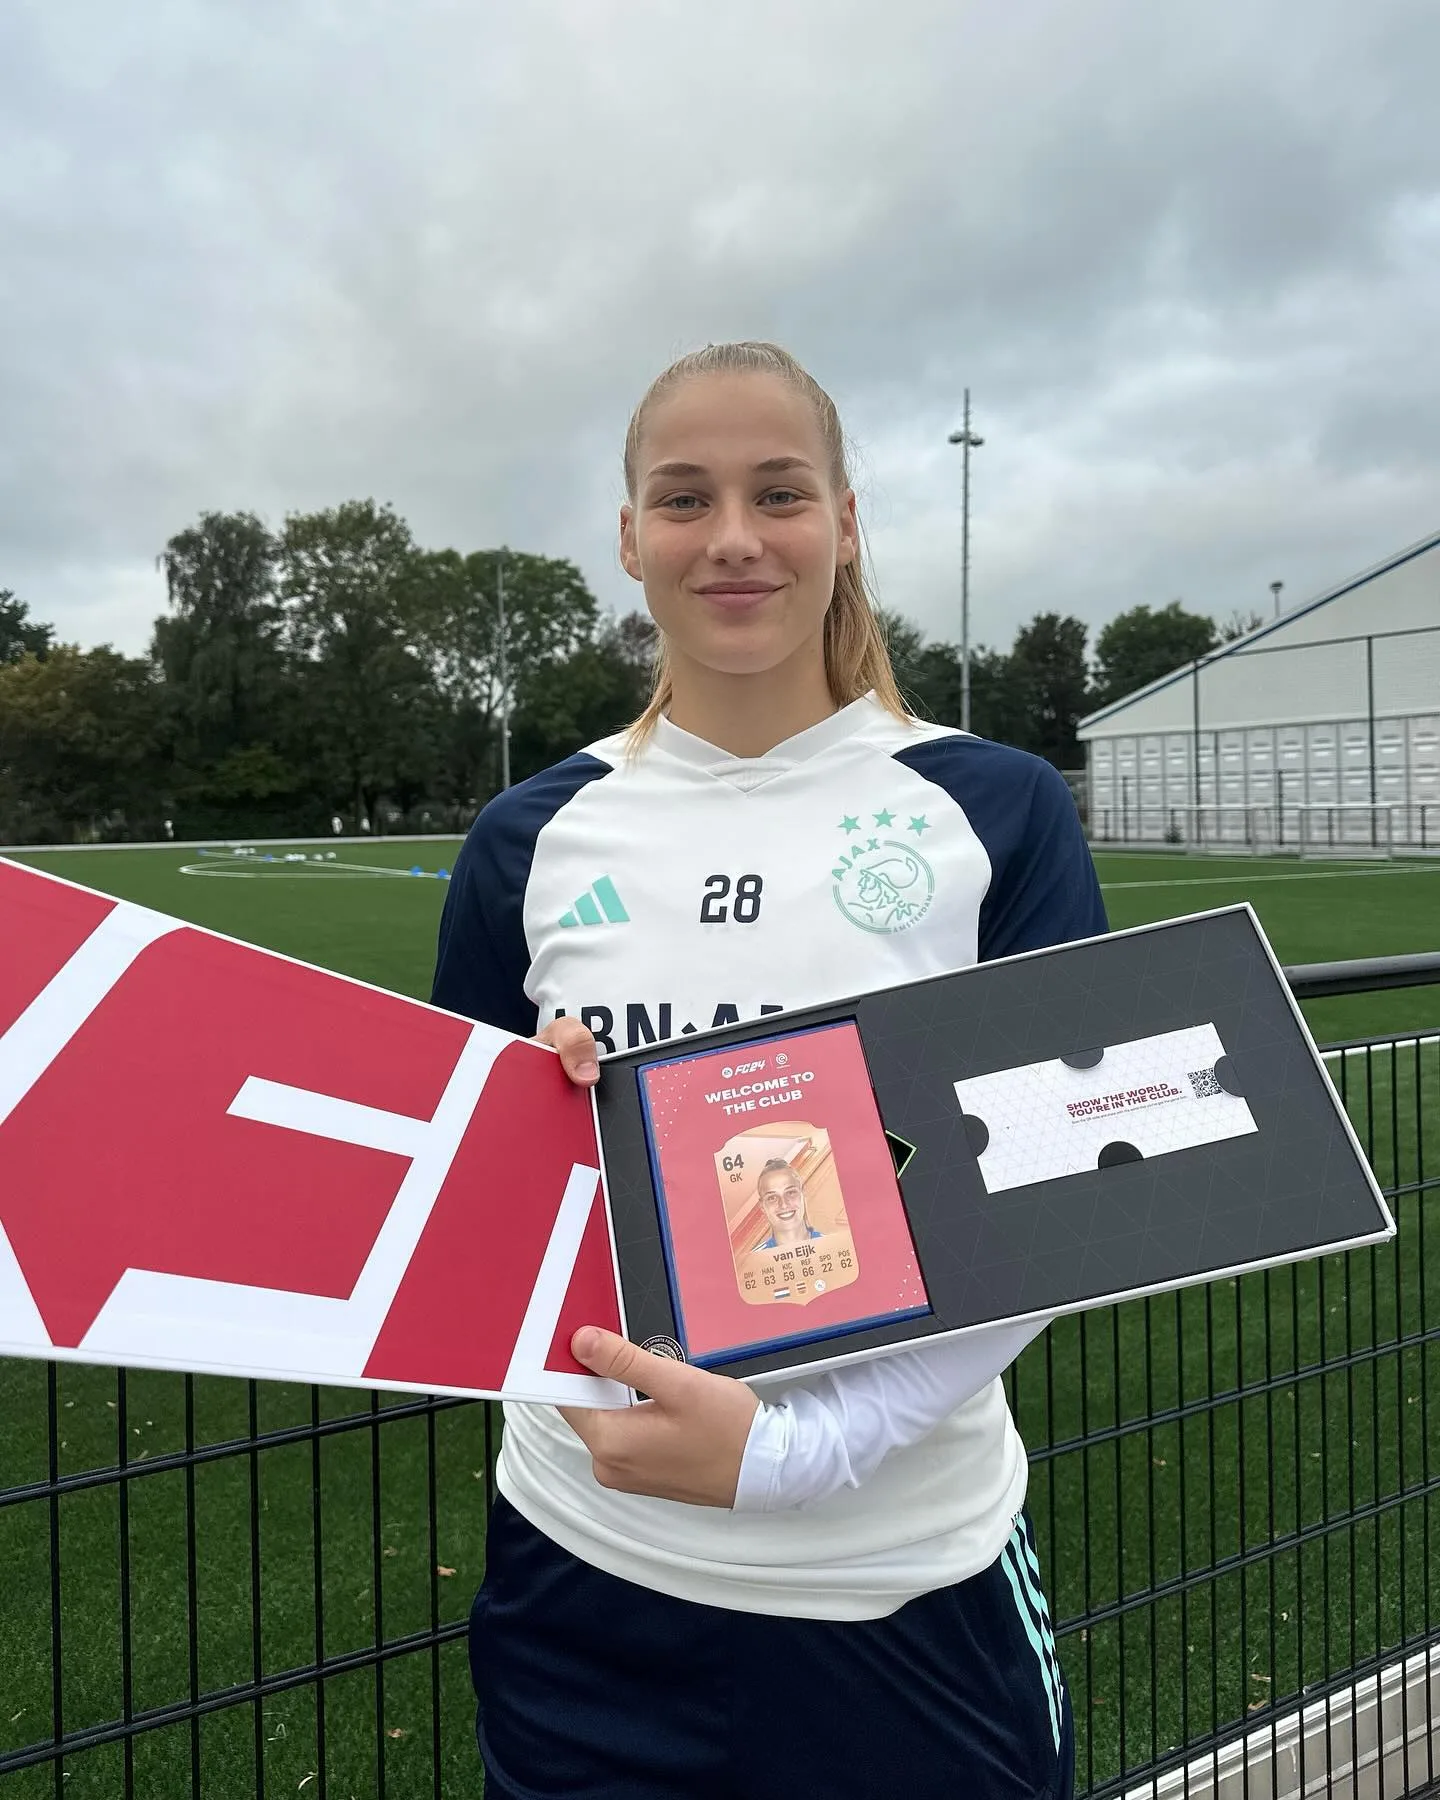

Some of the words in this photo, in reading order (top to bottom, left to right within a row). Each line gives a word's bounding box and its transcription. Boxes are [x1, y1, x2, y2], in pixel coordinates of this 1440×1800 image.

[832, 838, 880, 881] AJAX
[700, 874, 763, 923] 28
[893, 895, 933, 933] AMSTERDAM
[704, 1077, 790, 1104] WELCOME
[791, 1071, 815, 1084] TO
[1066, 1097, 1101, 1111] SHOW
[1102, 1092, 1126, 1103] THE
[1126, 1083, 1168, 1097] WORLD
[722, 1100, 756, 1115] THE
[758, 1090, 803, 1108] CLUB
[1069, 1104, 1111, 1118] YOU'RE
[1112, 1101, 1124, 1110] IN
[1124, 1095, 1149, 1107] THE
[1149, 1087, 1183, 1101] CLUB.
[722, 1154, 744, 1172] 64
[730, 1173, 743, 1183] GK
[761, 1267, 775, 1275] HAN
[800, 1258, 812, 1266] REF
[838, 1250, 850, 1258] POS
[773, 1250, 794, 1262] van
[795, 1245, 816, 1258] Eijk
[745, 1280, 757, 1290] 62
[764, 1275, 776, 1286] 63
[783, 1271, 795, 1281] 59
[802, 1267, 814, 1277] 66
[821, 1262, 833, 1273] 22
[840, 1258, 852, 1268] 62
